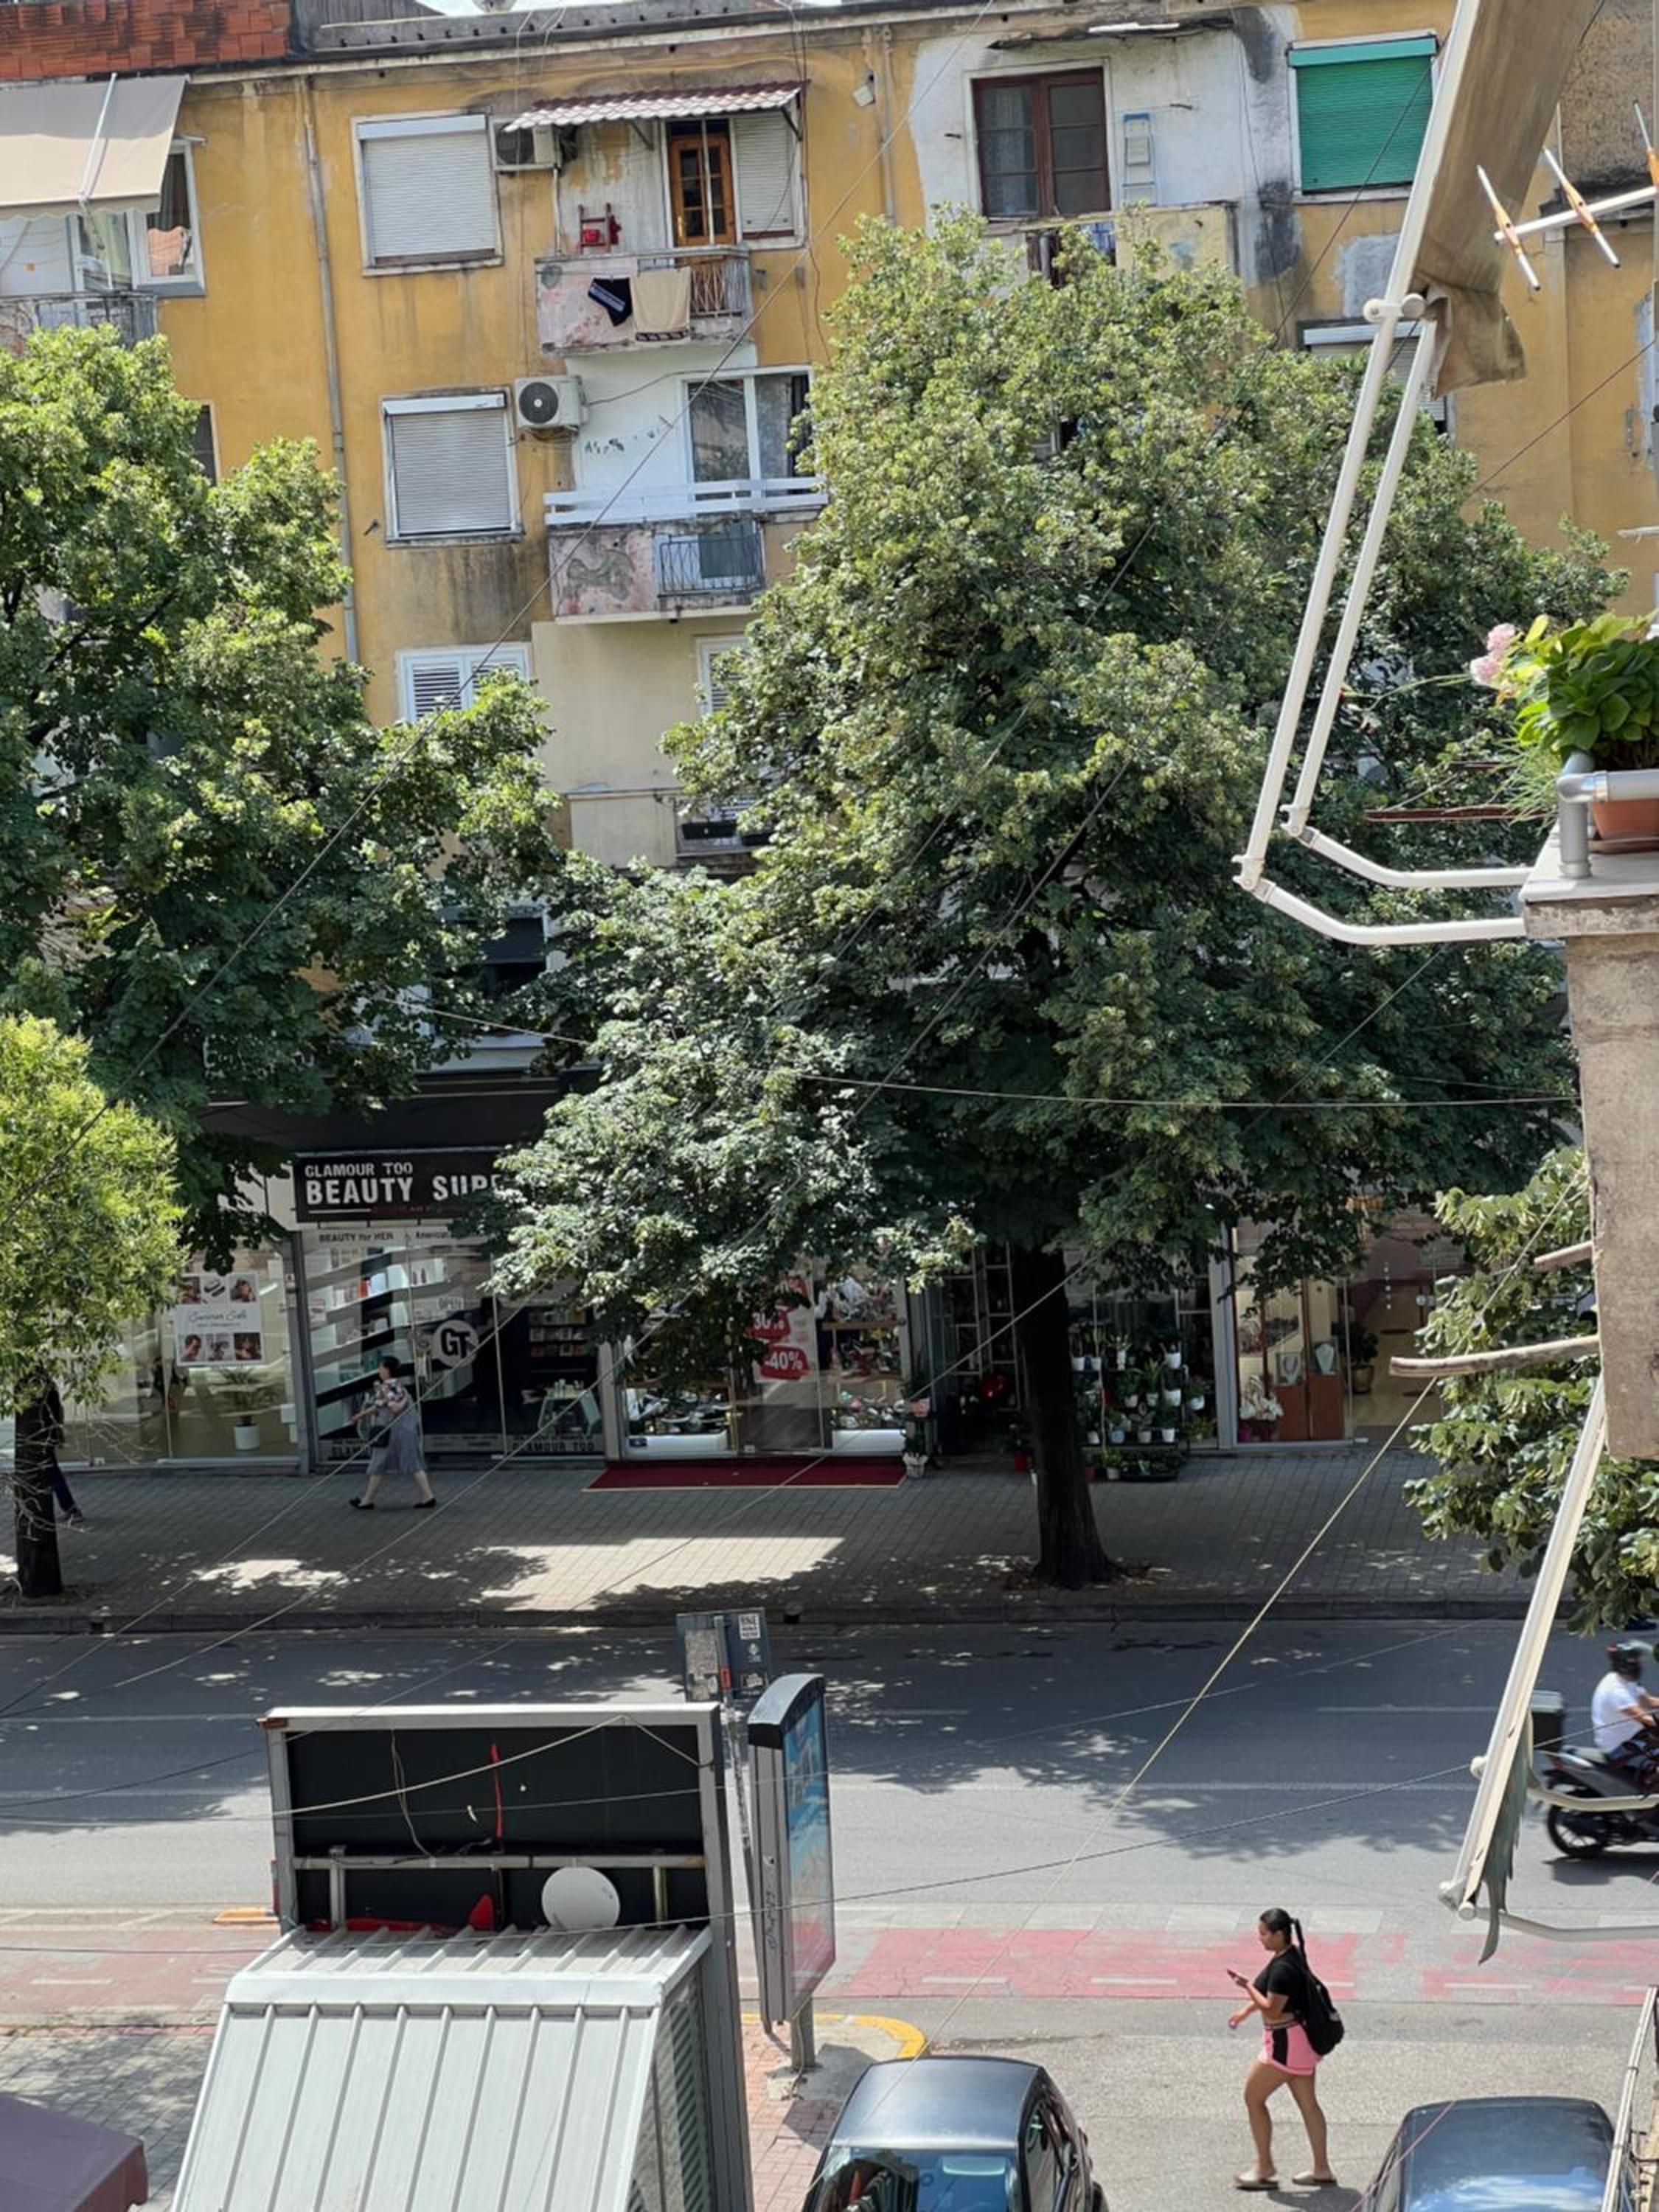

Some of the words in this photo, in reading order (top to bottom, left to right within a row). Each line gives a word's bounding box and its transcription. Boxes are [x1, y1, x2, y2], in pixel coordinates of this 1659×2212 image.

[305, 1163, 375, 1178] GLAMOUR
[383, 1161, 413, 1175] TOO
[306, 1178, 413, 1205] BEAUTY
[319, 1233, 357, 1243] BEAUTY
[441, 1328, 470, 1359] GT
